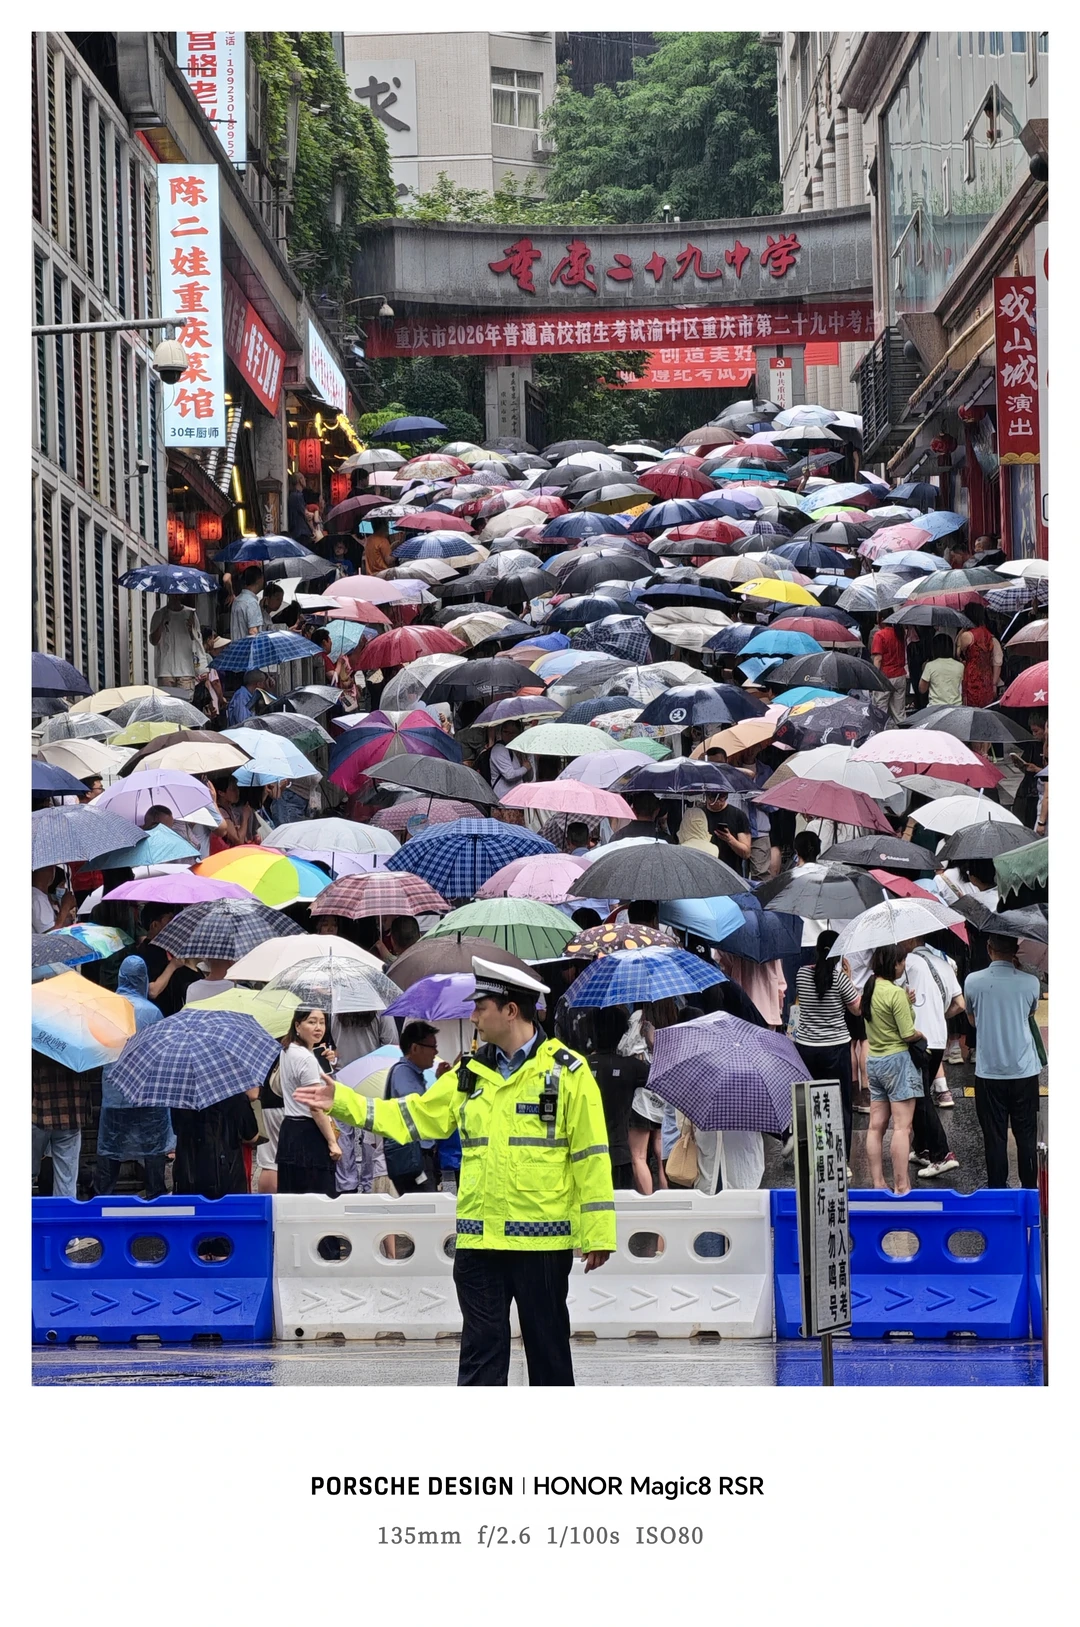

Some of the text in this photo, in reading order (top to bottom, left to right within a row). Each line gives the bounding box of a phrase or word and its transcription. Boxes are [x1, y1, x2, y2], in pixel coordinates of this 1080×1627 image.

[168, 176, 215, 418] 陈二娃重庆菜馆
[170, 427, 219, 438] 30年厨师
[813, 1091, 825, 1216] 减速慢行
[836, 1134, 848, 1319] 你已进入高考
